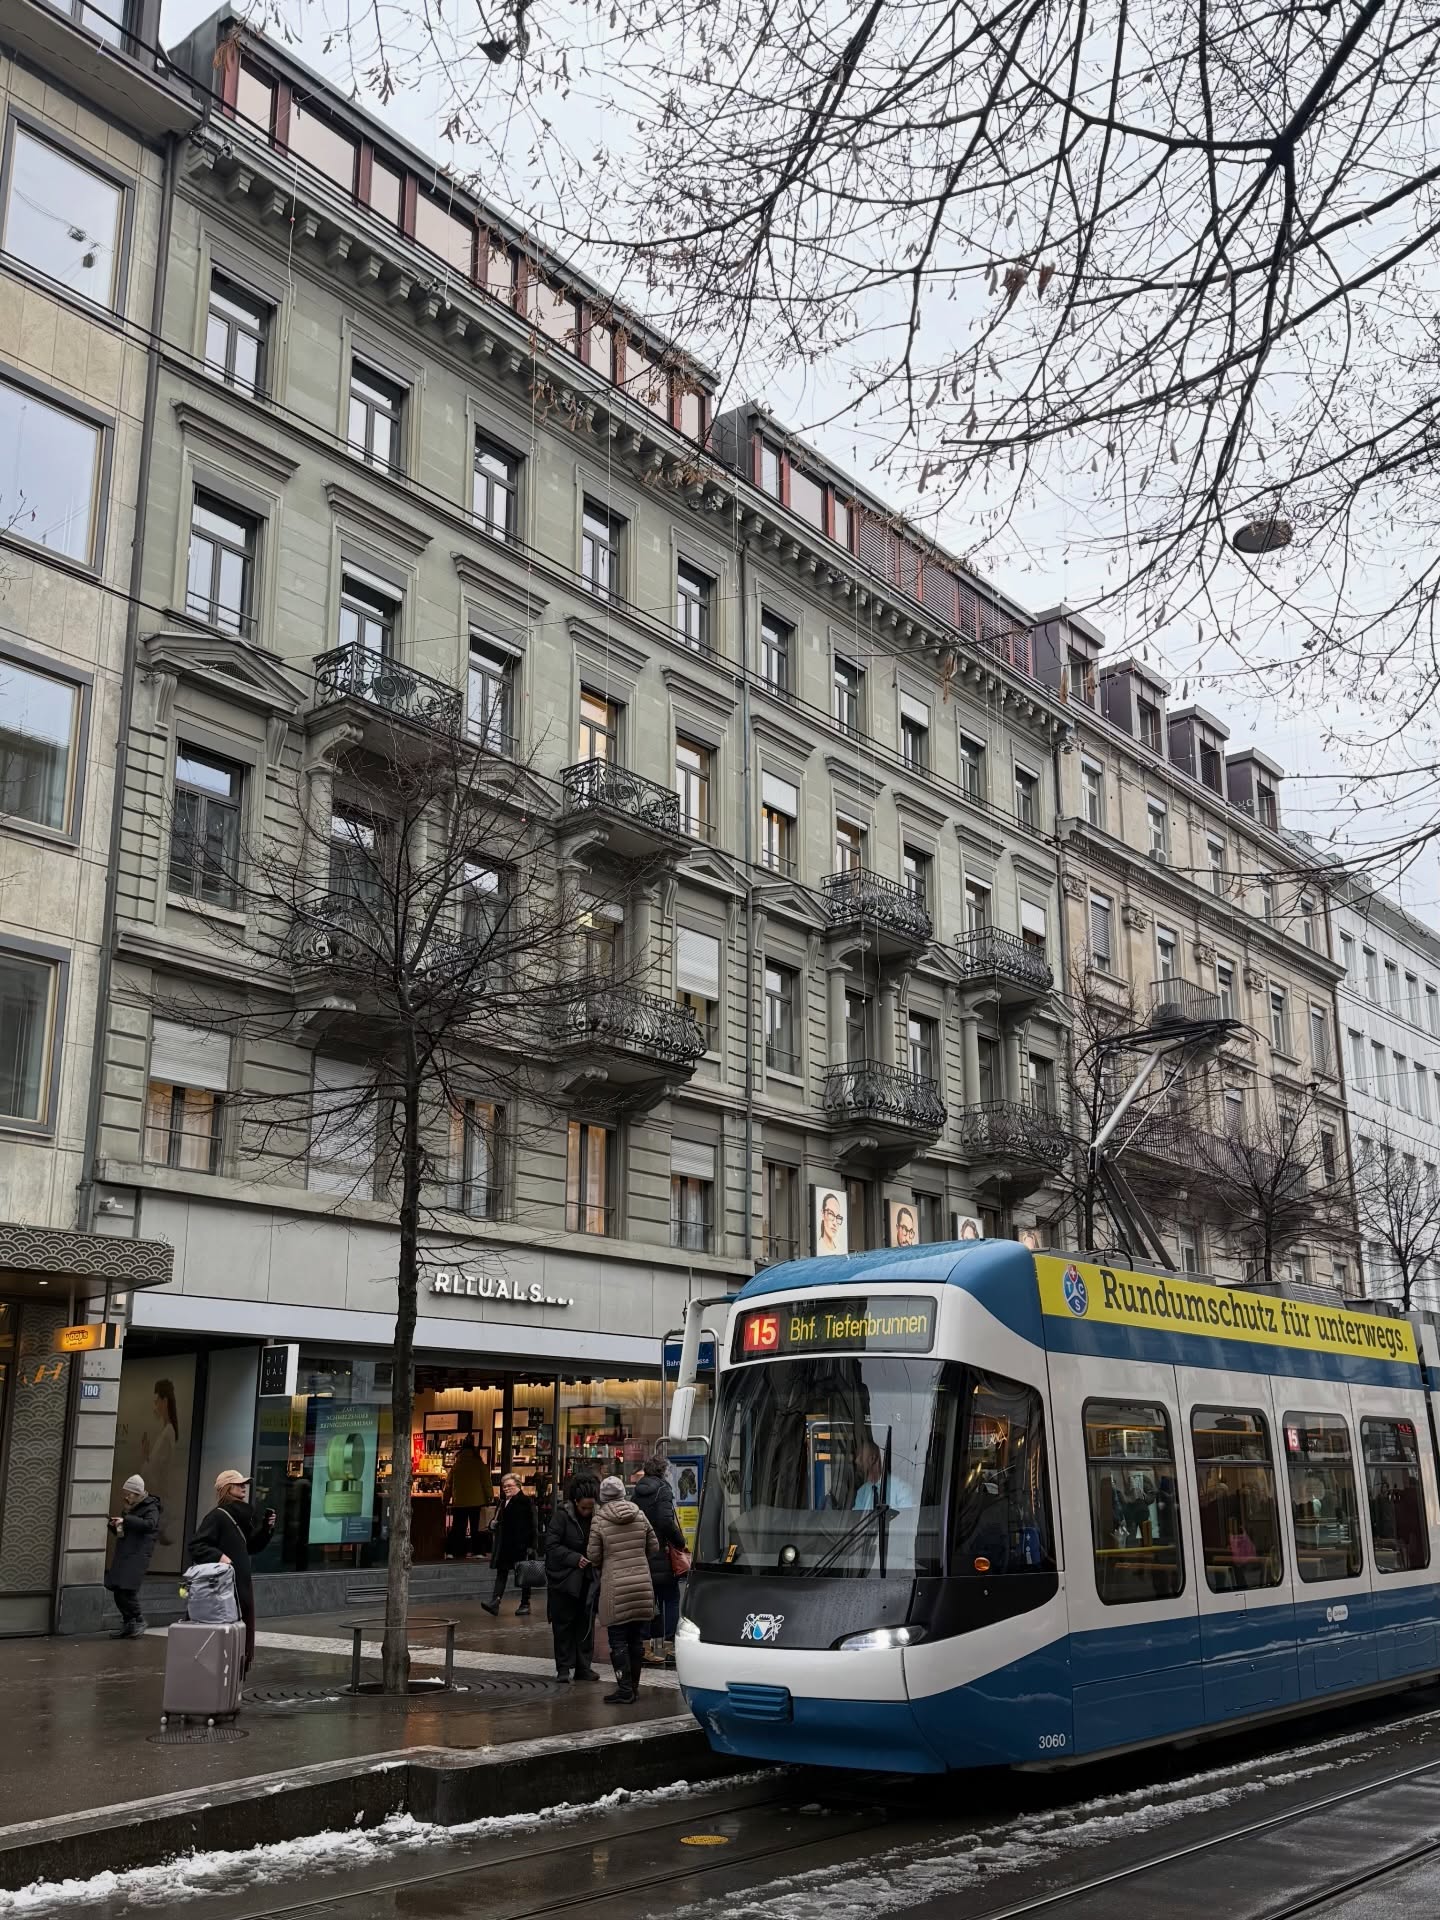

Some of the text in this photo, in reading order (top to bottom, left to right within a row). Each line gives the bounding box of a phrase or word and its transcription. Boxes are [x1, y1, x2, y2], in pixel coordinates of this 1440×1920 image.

[1100, 1269, 1408, 1358] Rundumschutz für unterwegs.
[749, 1318, 777, 1346] 15
[789, 1311, 927, 1342] Bhf. Tiefenbrunnen
[84, 1385, 98, 1396] 100
[1287, 1429, 1298, 1447] 15
[1038, 1733, 1066, 1749] 3060
